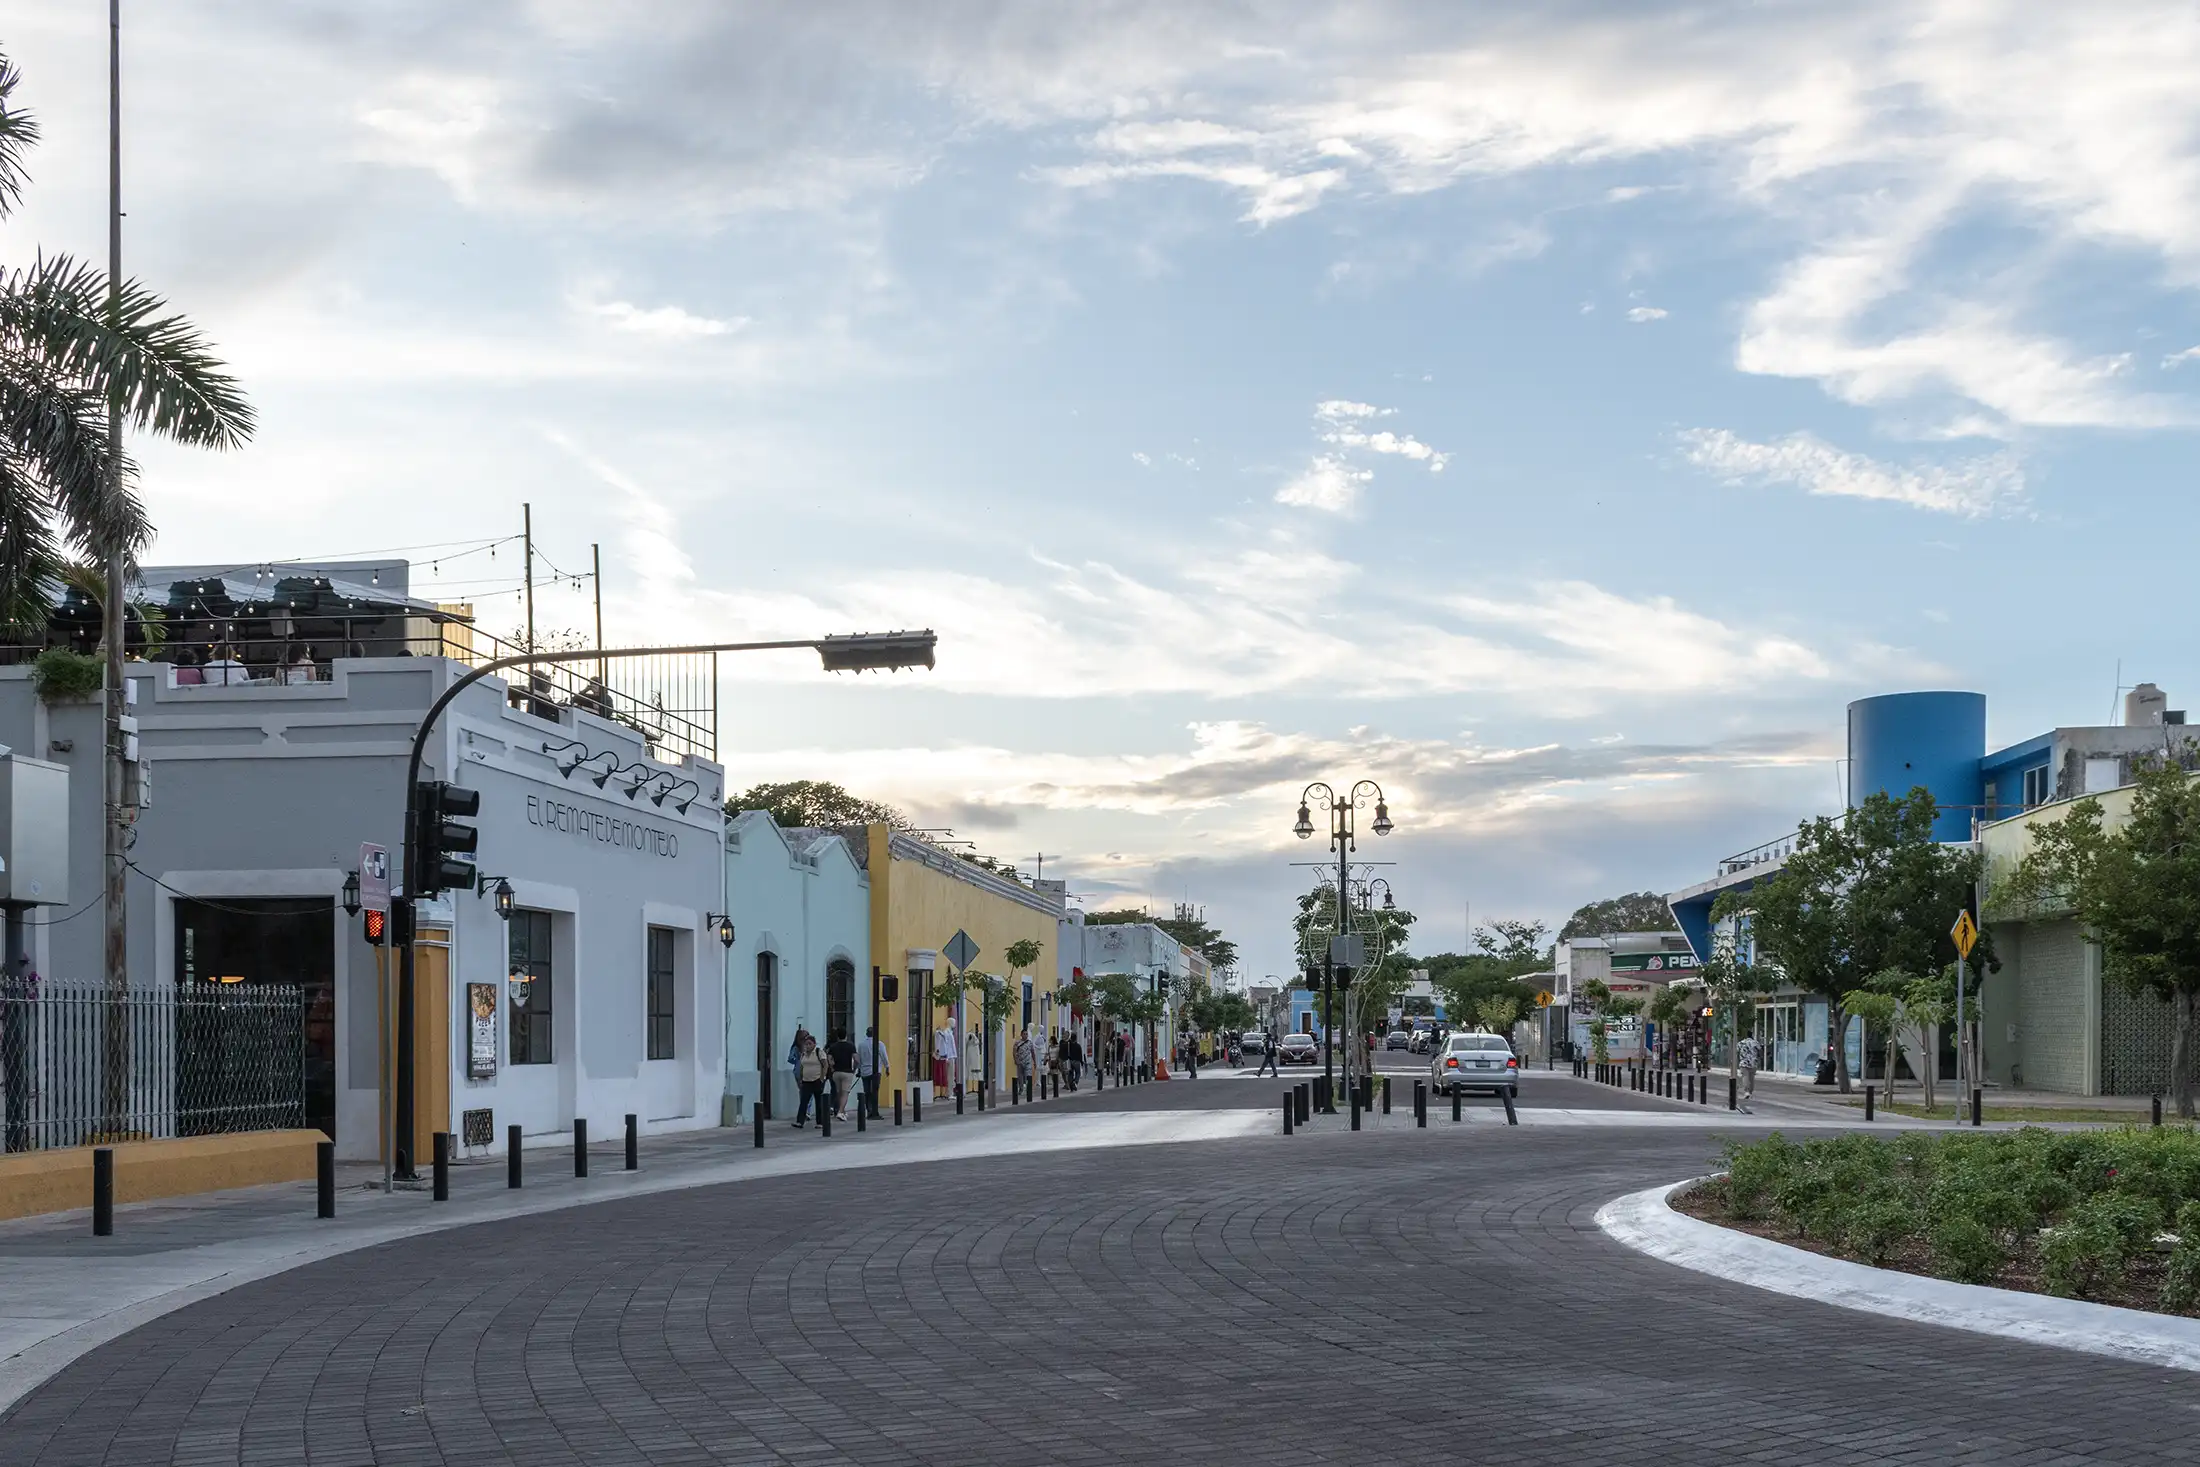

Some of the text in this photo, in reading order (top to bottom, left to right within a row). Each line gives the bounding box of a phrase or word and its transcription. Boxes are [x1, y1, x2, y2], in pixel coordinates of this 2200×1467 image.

[546, 800, 604, 842] REMATE
[605, 816, 621, 846] DE
[622, 821, 678, 858] MONTEJO
